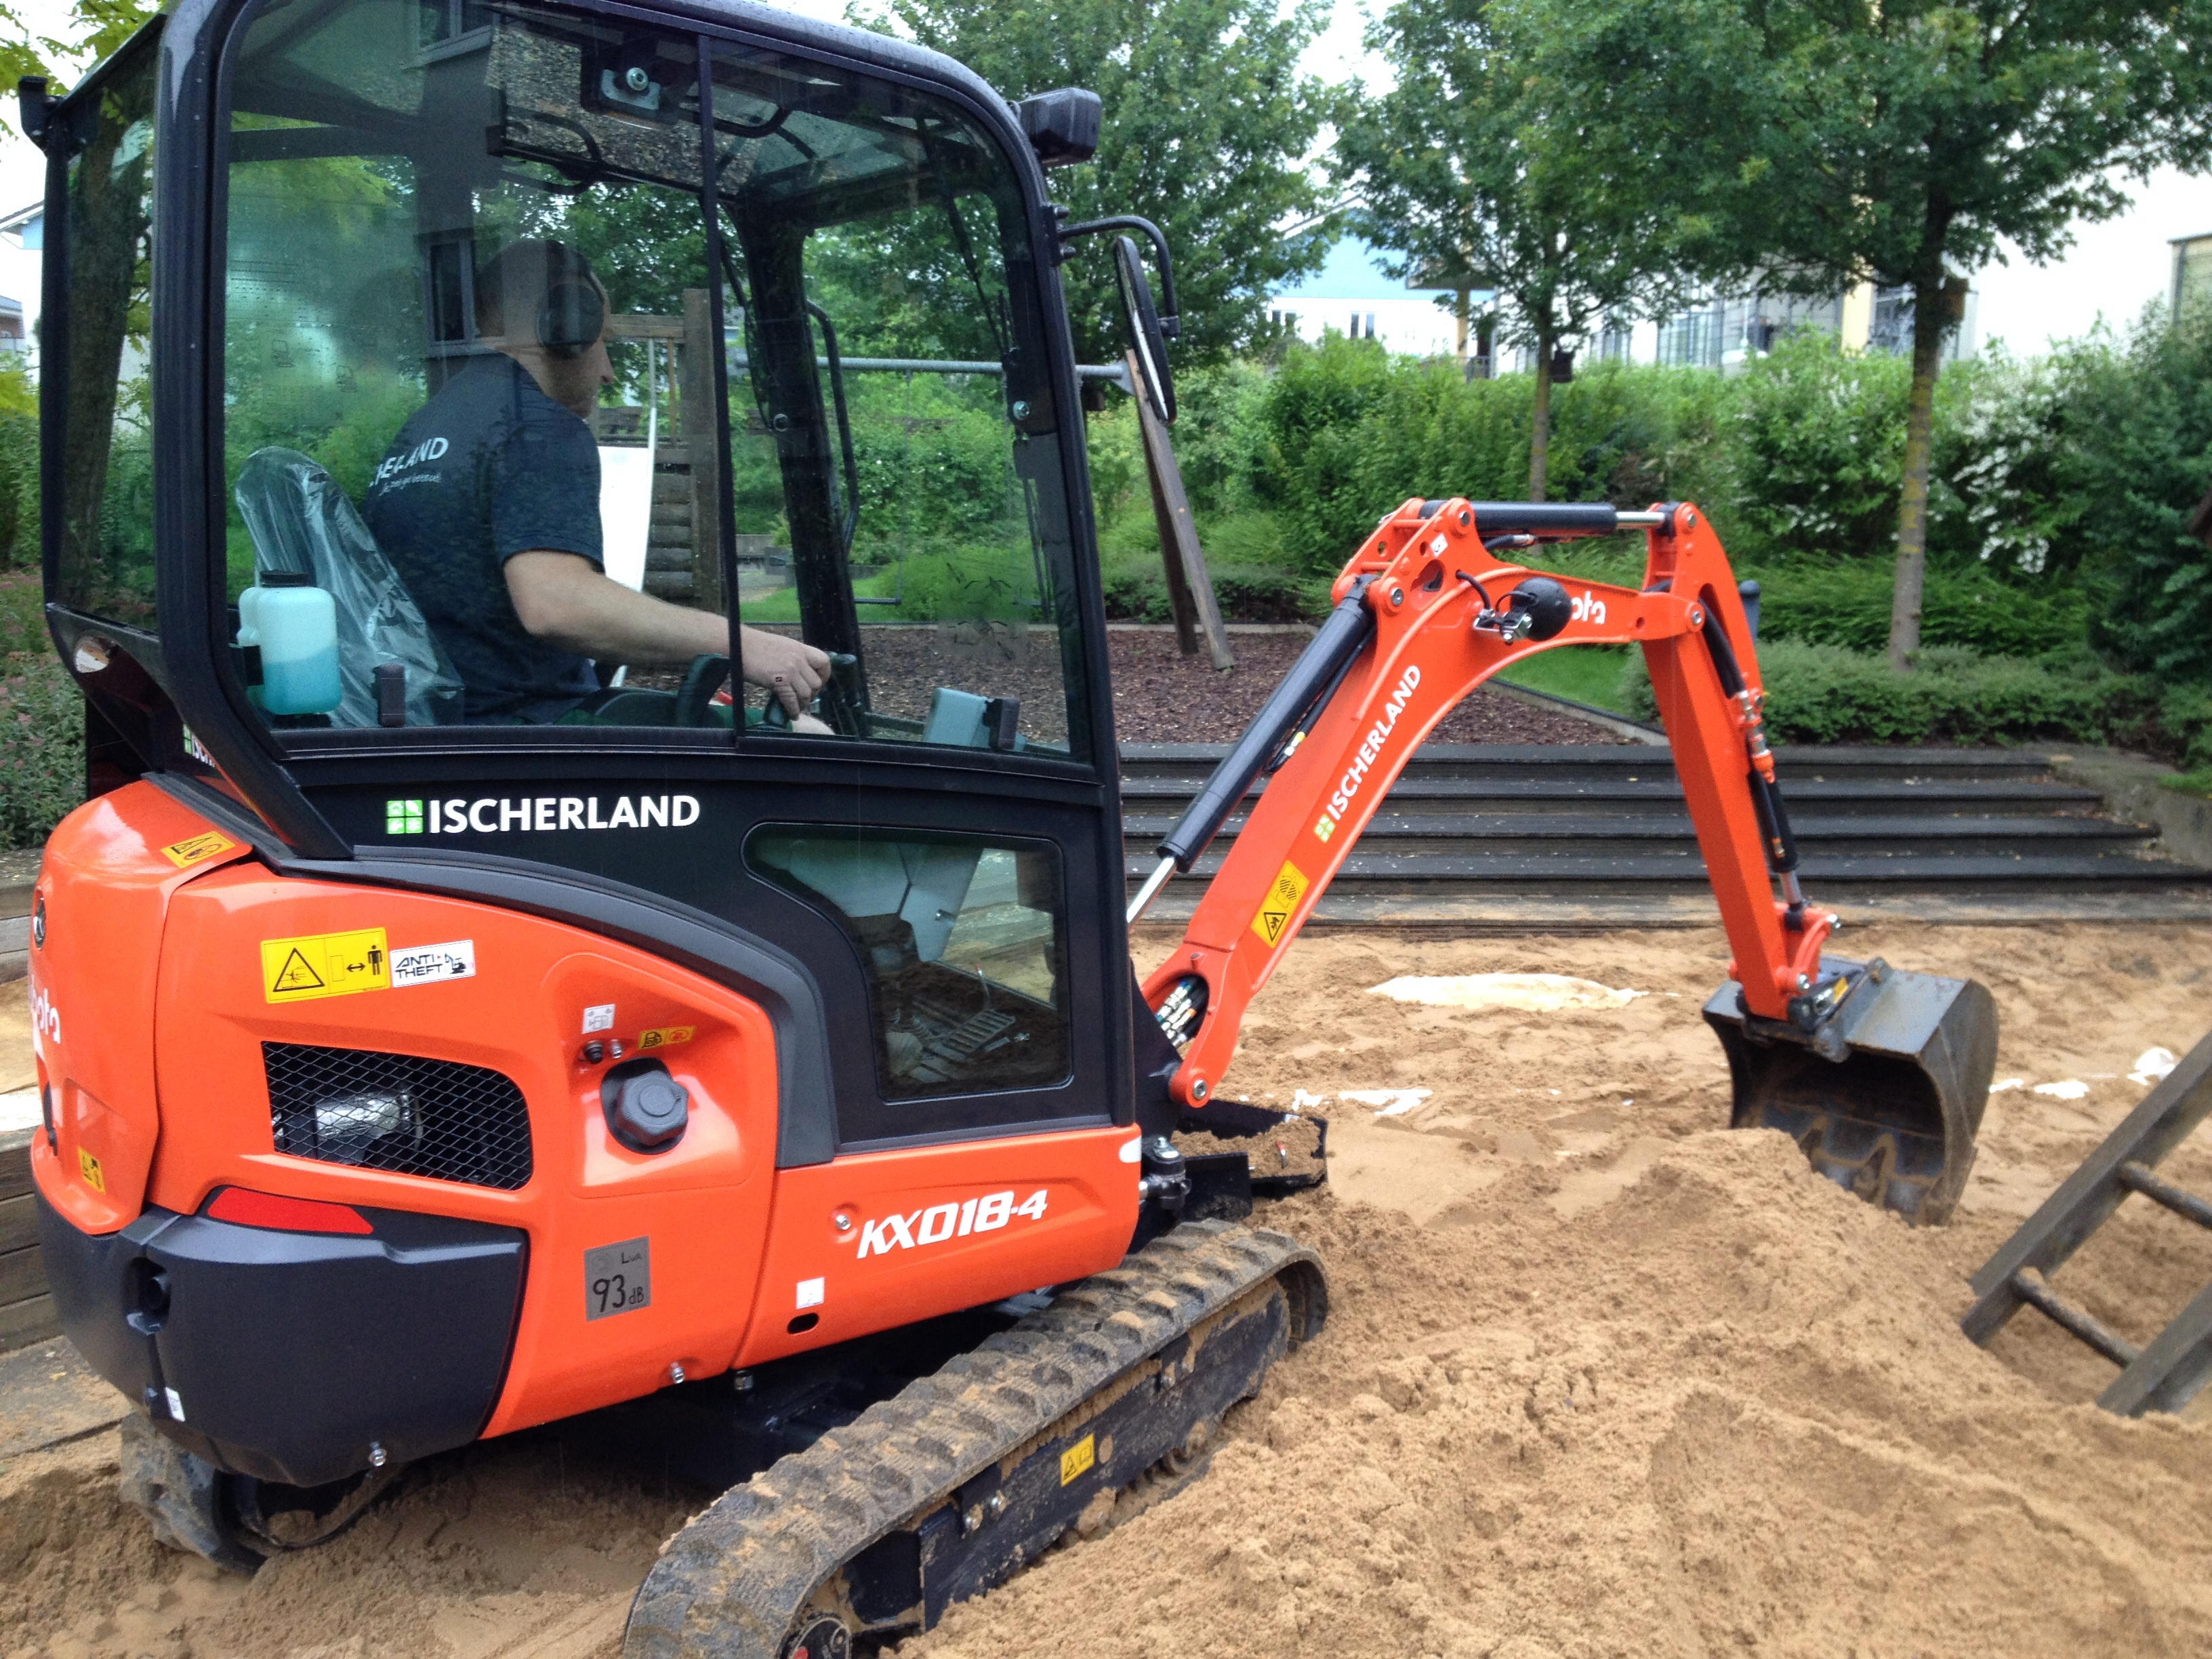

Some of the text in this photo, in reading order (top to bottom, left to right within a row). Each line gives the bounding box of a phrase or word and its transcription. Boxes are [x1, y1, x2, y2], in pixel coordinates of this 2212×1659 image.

[1571, 590, 1606, 624] ota
[1326, 665, 1420, 821] ISCHERLAND
[429, 795, 700, 834] ISCHERLAND
[394, 963, 443, 979] THEFT
[396, 954, 435, 968] ANTI
[856, 1190, 1048, 1259] KX018-4
[593, 1274, 644, 1313] 93 dB
